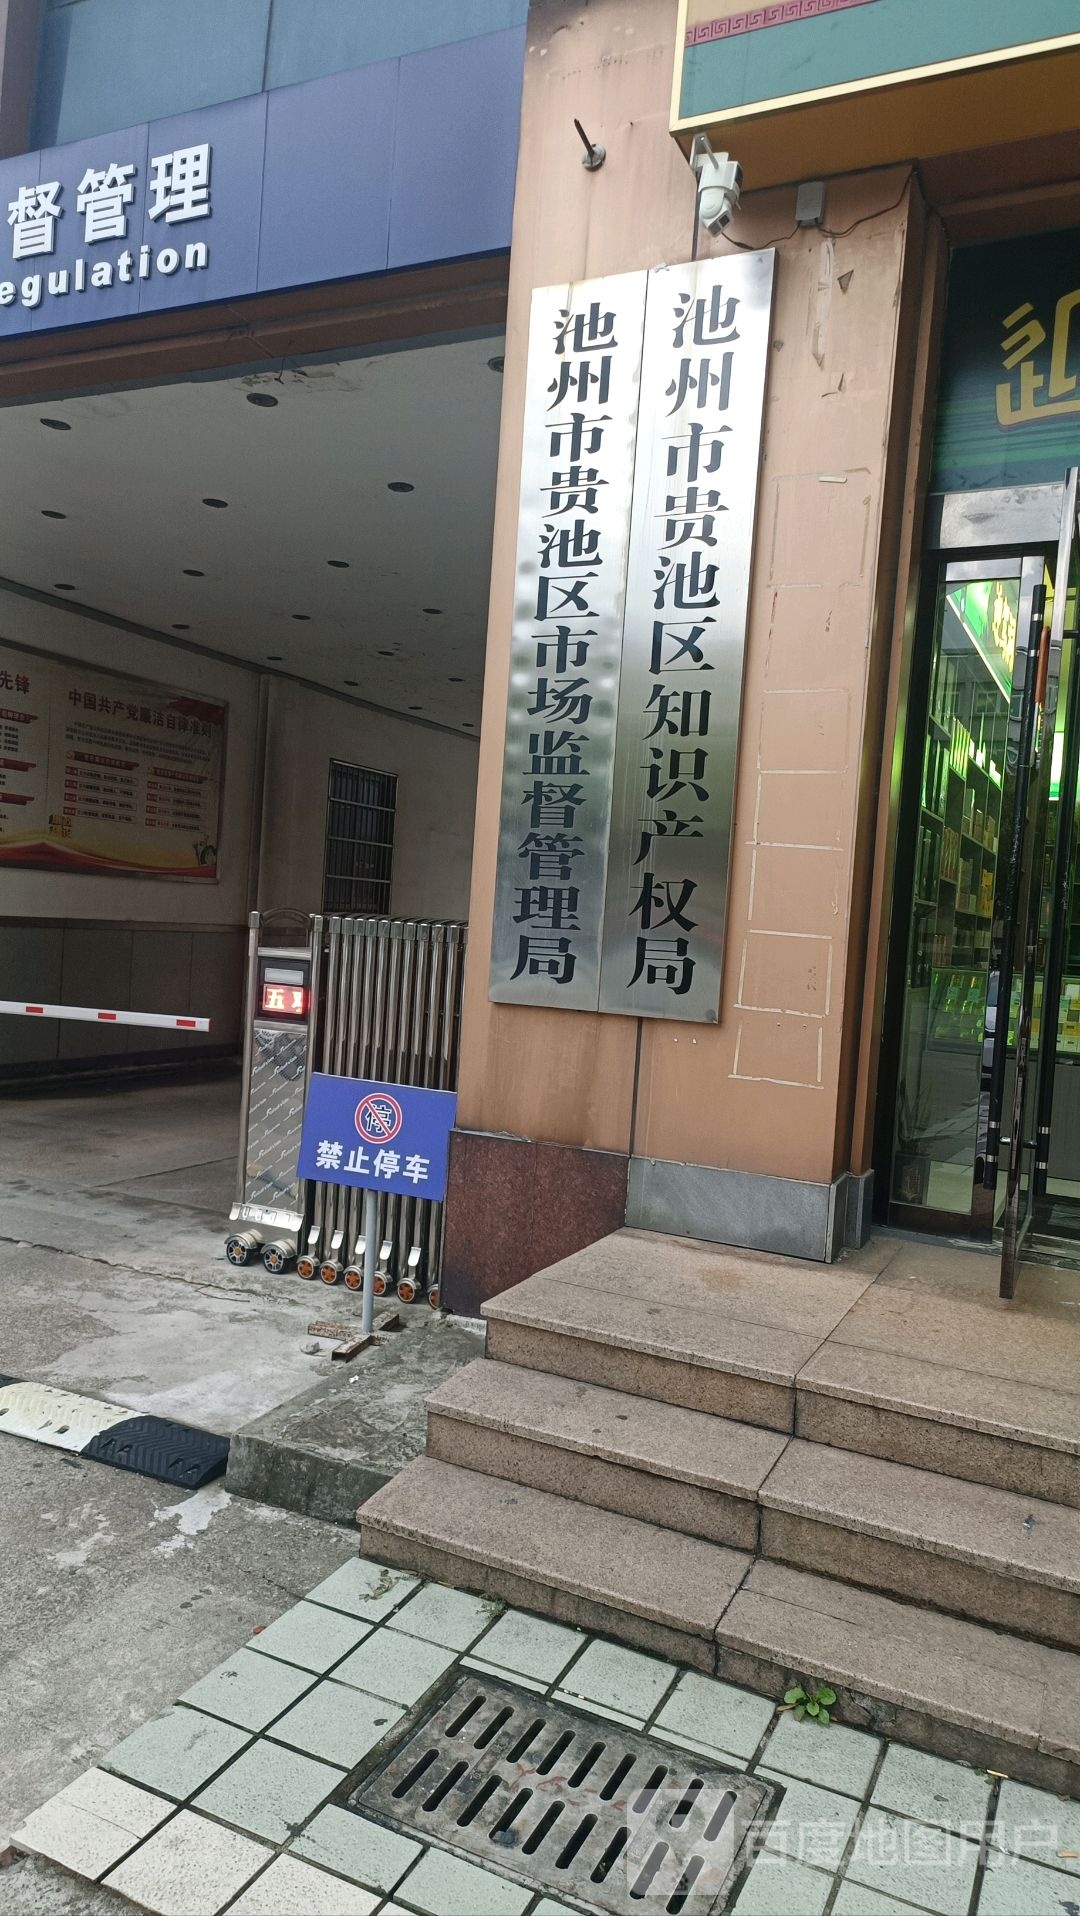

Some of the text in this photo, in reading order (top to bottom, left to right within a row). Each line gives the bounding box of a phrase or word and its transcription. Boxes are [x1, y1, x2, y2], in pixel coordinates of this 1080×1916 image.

[7, 143, 212, 260] 督管理
[509, 302, 618, 985] 池州市贵池区市场监督管理局
[627, 285, 740, 995] 池州市贵池区知识产权局
[68, 688, 212, 738] 中国共产党廉洁自律准则
[315, 1140, 430, 1184] 禁止停车
